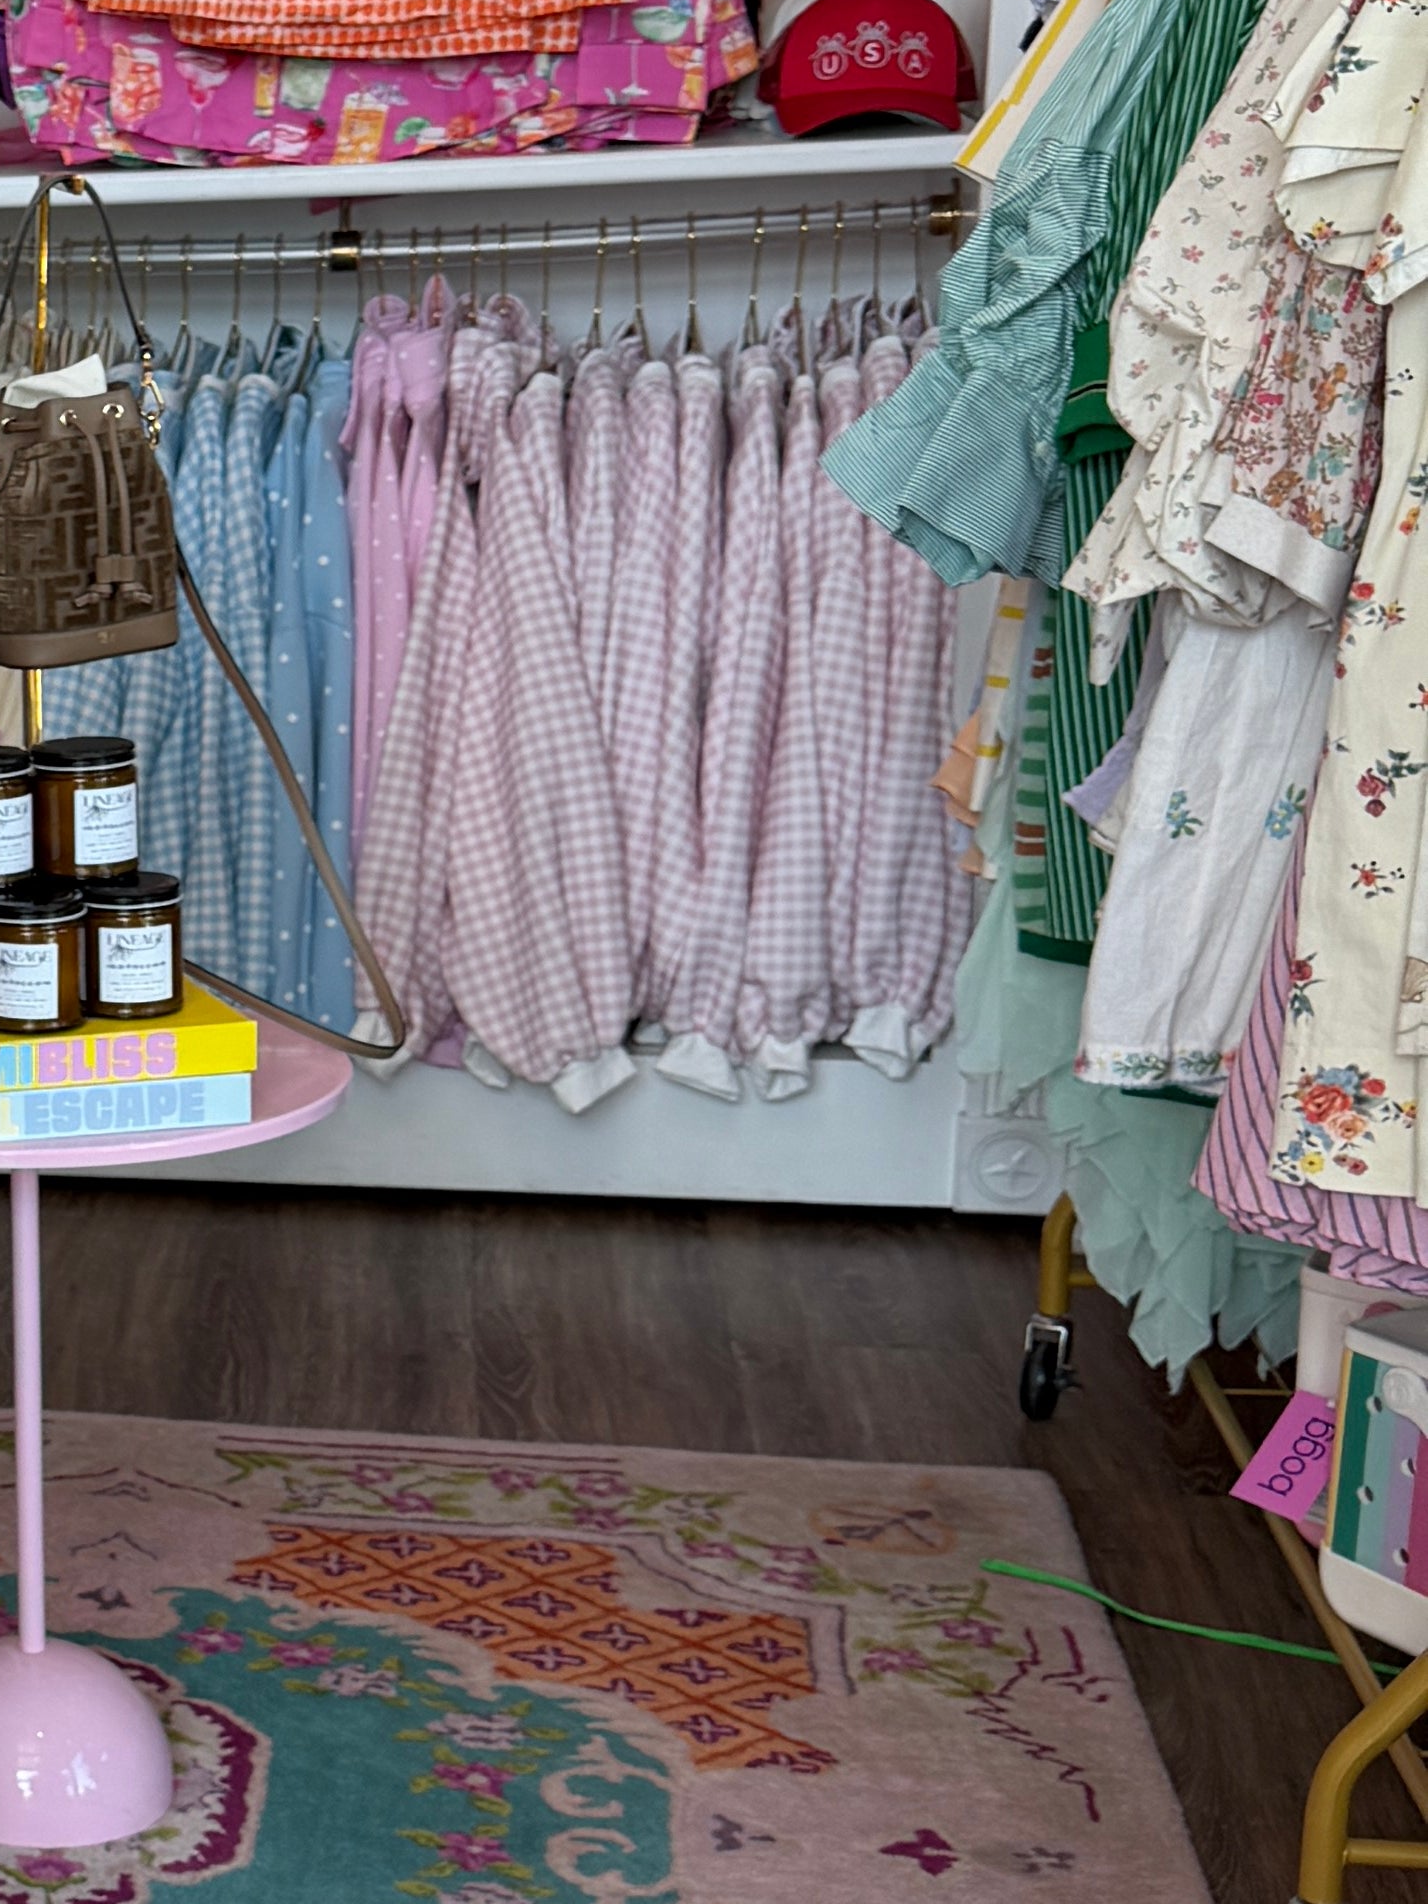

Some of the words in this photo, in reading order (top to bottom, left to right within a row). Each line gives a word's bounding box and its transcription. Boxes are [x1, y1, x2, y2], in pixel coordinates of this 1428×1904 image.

[37, 1032, 177, 1085] BLISS
[24, 1082, 205, 1136] ESCAPE
[1257, 1417, 1335, 1496] bogg
